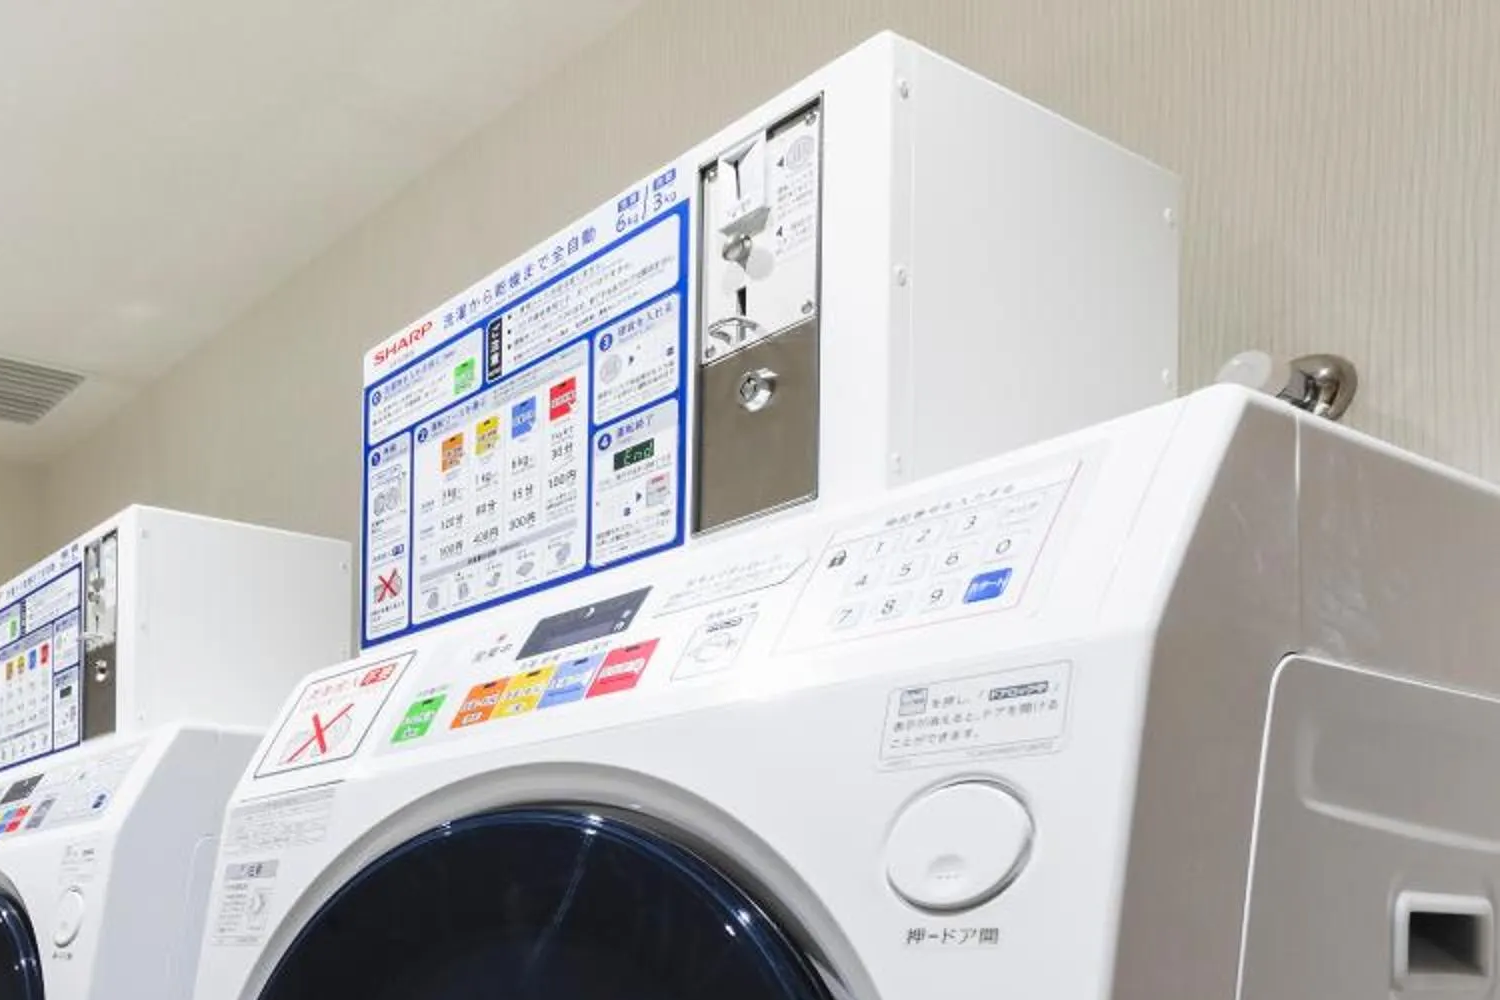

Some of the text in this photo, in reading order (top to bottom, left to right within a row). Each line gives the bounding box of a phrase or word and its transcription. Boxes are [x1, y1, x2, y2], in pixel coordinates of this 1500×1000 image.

[372, 321, 434, 368] SHARP
[915, 527, 932, 544] 2
[963, 514, 978, 532] 3
[898, 560, 912, 577] 5
[995, 538, 1012, 556] 0
[837, 587, 945, 625] 7 8 9
